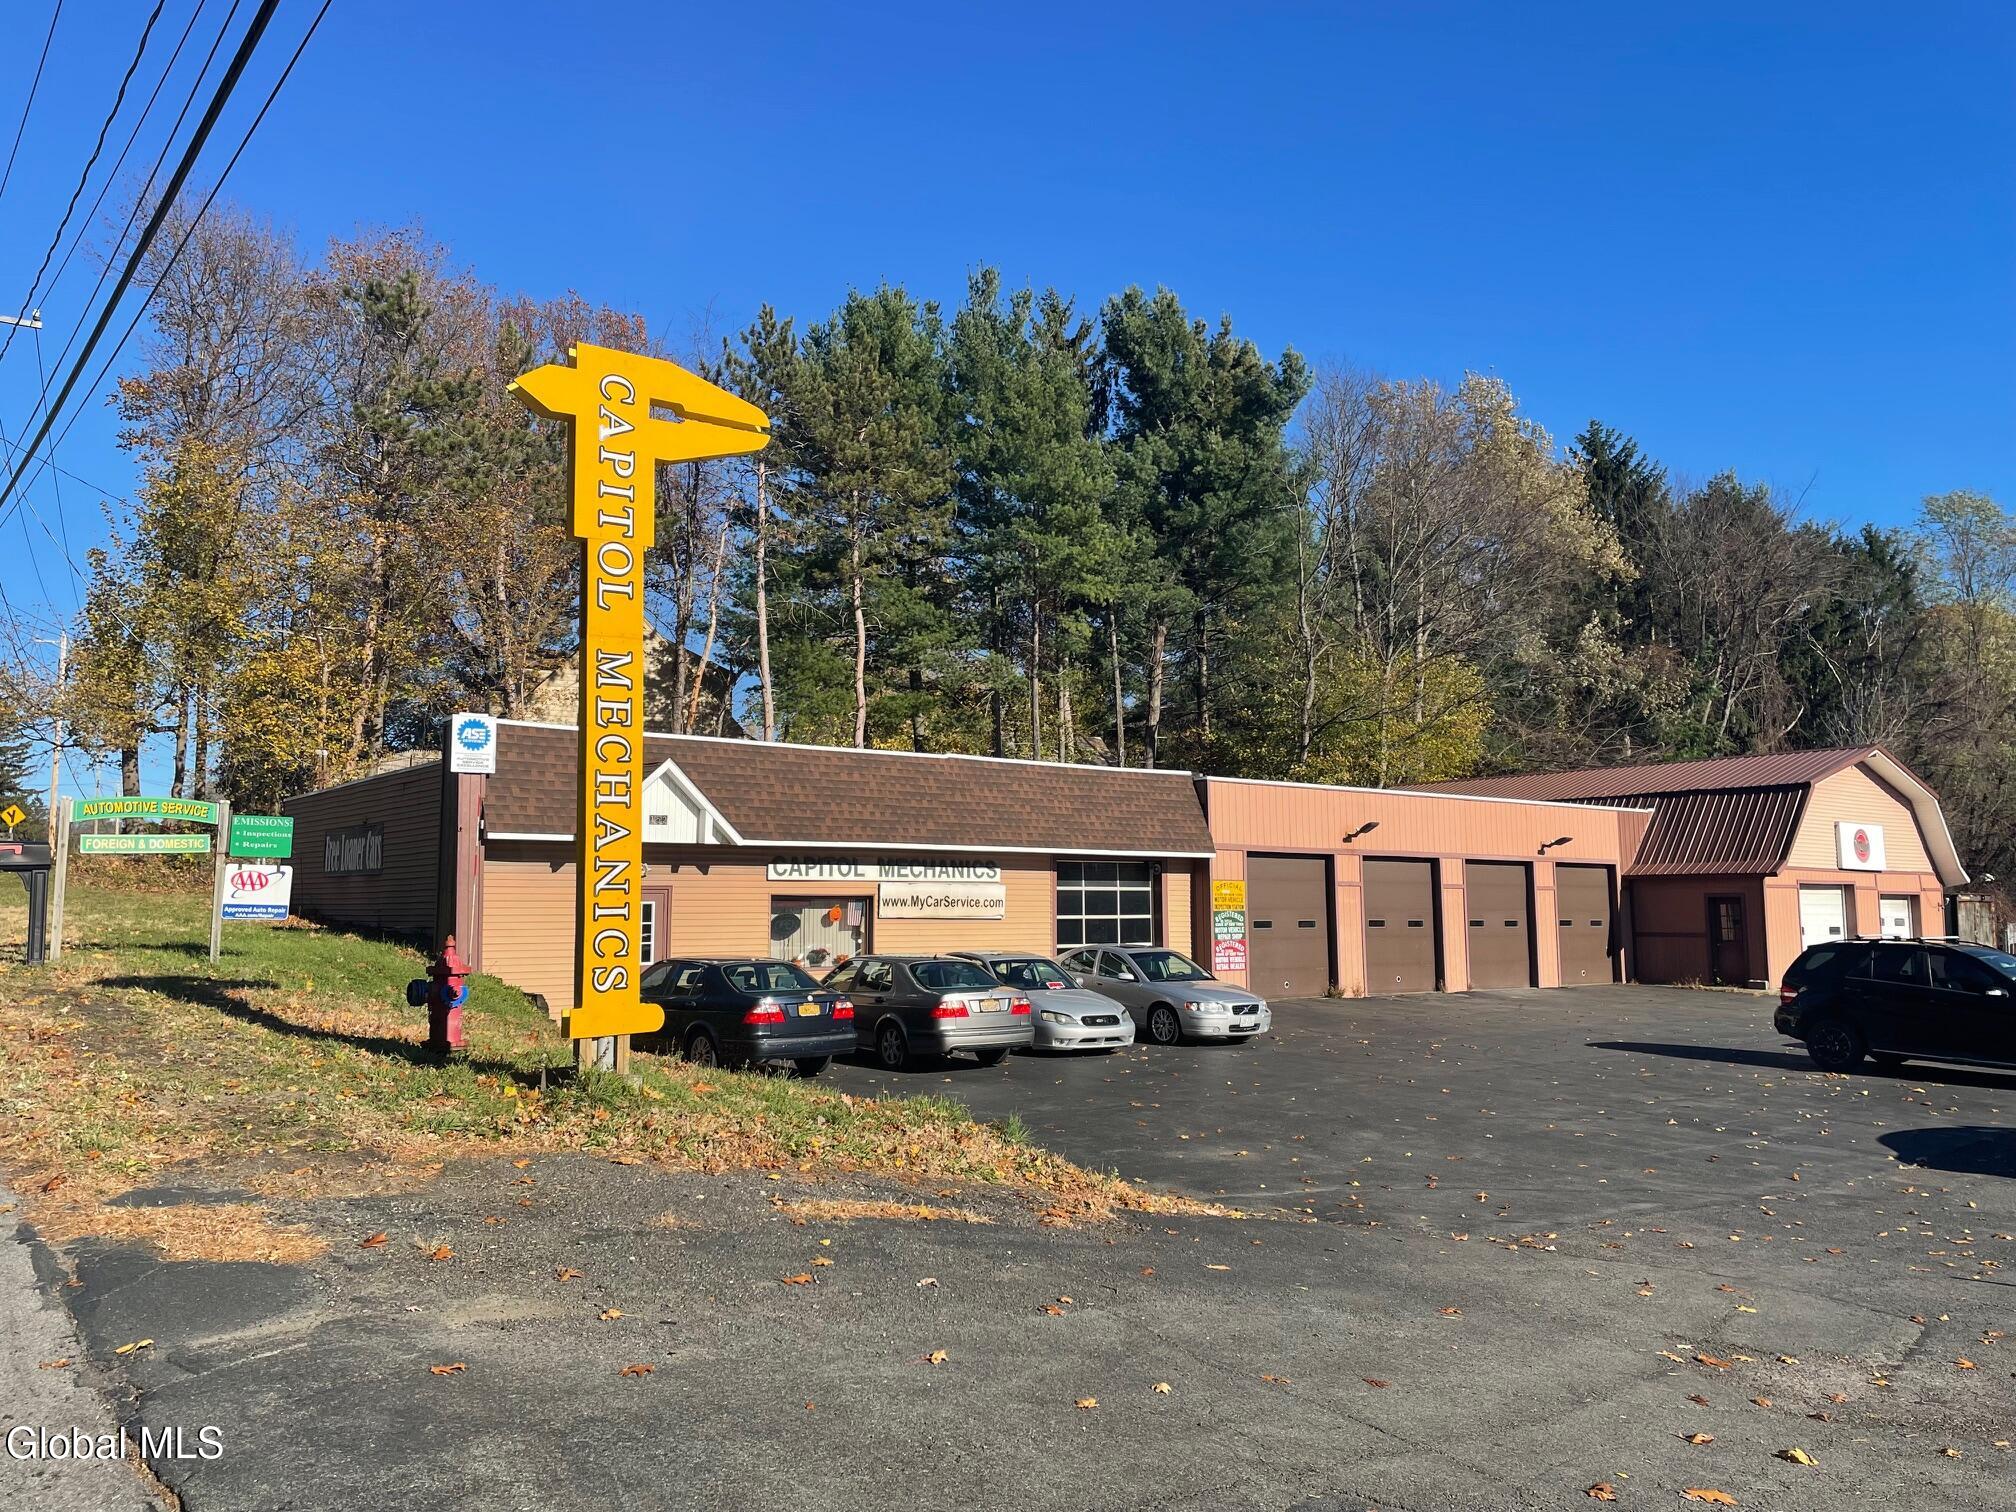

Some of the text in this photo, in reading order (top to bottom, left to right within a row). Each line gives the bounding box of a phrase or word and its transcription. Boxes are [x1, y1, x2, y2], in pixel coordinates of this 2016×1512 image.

[592, 374, 636, 993] CAPITOL MECHANICS
[461, 727, 486, 739] ASE
[83, 802, 208, 818] AUTOMOTIVE SERVICE
[233, 817, 294, 827] EMISSIONS:
[242, 830, 292, 838] Inspections
[85, 838, 205, 849] FOREIGN & DOMESTIC
[242, 841, 278, 849] Repairs
[324, 830, 382, 872] Free Loaner Cars
[770, 855, 998, 880] CAPITOL MECHANICS
[233, 871, 266, 891] AAA
[1216, 882, 1242, 892] OFFICIAL
[882, 895, 1004, 910] www.MyCarService.com
[1215, 911, 1244, 923] REGISTERED
[1215, 940, 1245, 952] REGISTERED
